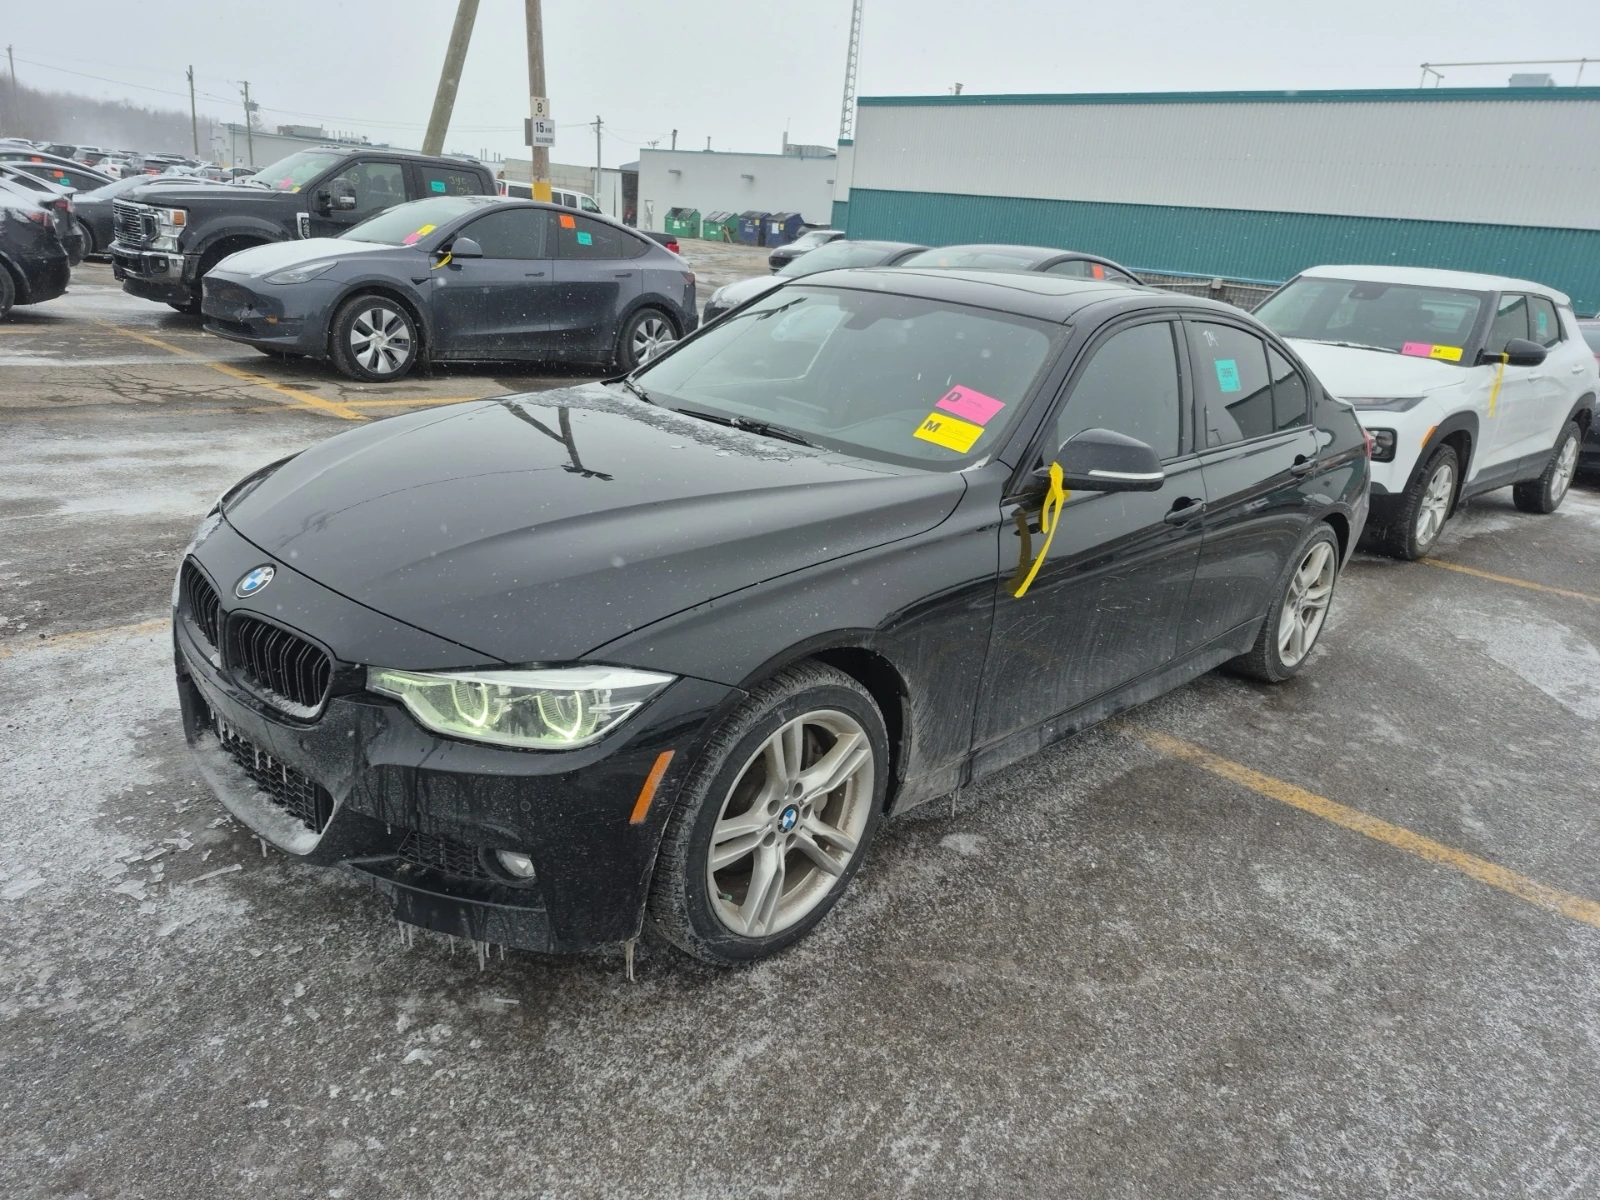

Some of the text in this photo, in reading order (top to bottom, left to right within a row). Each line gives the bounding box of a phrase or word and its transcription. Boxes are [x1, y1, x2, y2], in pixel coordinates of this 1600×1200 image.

[537, 102, 543, 113] 8
[535, 122, 545, 133] 15
[535, 136, 554, 144] MAXIMUM
[945, 391, 963, 403] D
[923, 419, 941, 433] M
